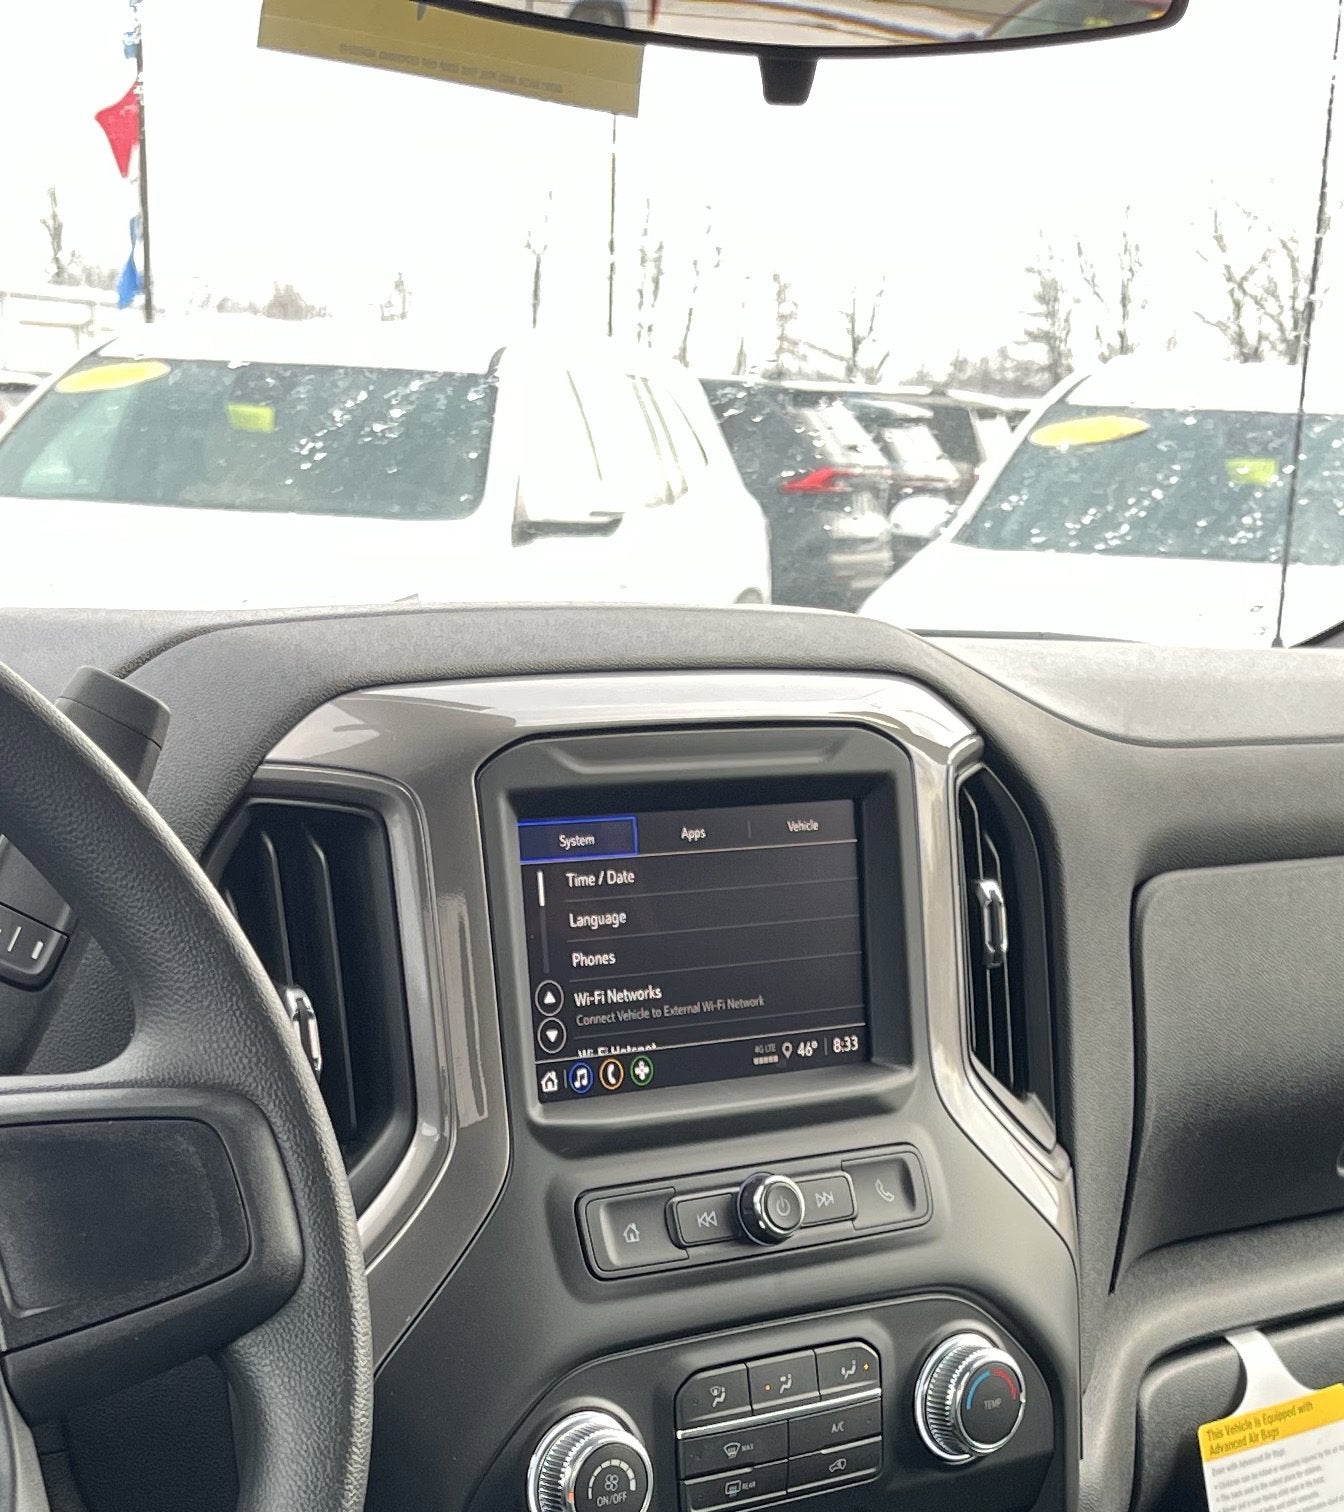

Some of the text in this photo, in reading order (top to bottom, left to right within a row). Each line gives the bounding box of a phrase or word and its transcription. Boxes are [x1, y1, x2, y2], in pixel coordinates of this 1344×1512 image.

[681, 826, 706, 842] Apps
[787, 819, 819, 833] Vehicle
[559, 834, 595, 850] System
[566, 872, 596, 888] Time
[607, 870, 635, 885] Date
[569, 911, 627, 930] Language
[572, 952, 616, 967] Phones
[574, 985, 662, 1007] Wi-Fi Networks
[576, 994, 765, 1027] Connect Vehicle to External Wi-Fi Network
[832, 1035, 859, 1053] 8:33
[831, 1421, 845, 1433] A/C
[1206, 1428, 1224, 1441] This
[1224, 1418, 1253, 1436] Vehicle
[1262, 1404, 1296, 1426] Equipped
[1297, 1401, 1313, 1414] with
[1209, 1427, 1280, 1456] Advanced Air Bags
[596, 1490, 627, 1507] ON/OFF
